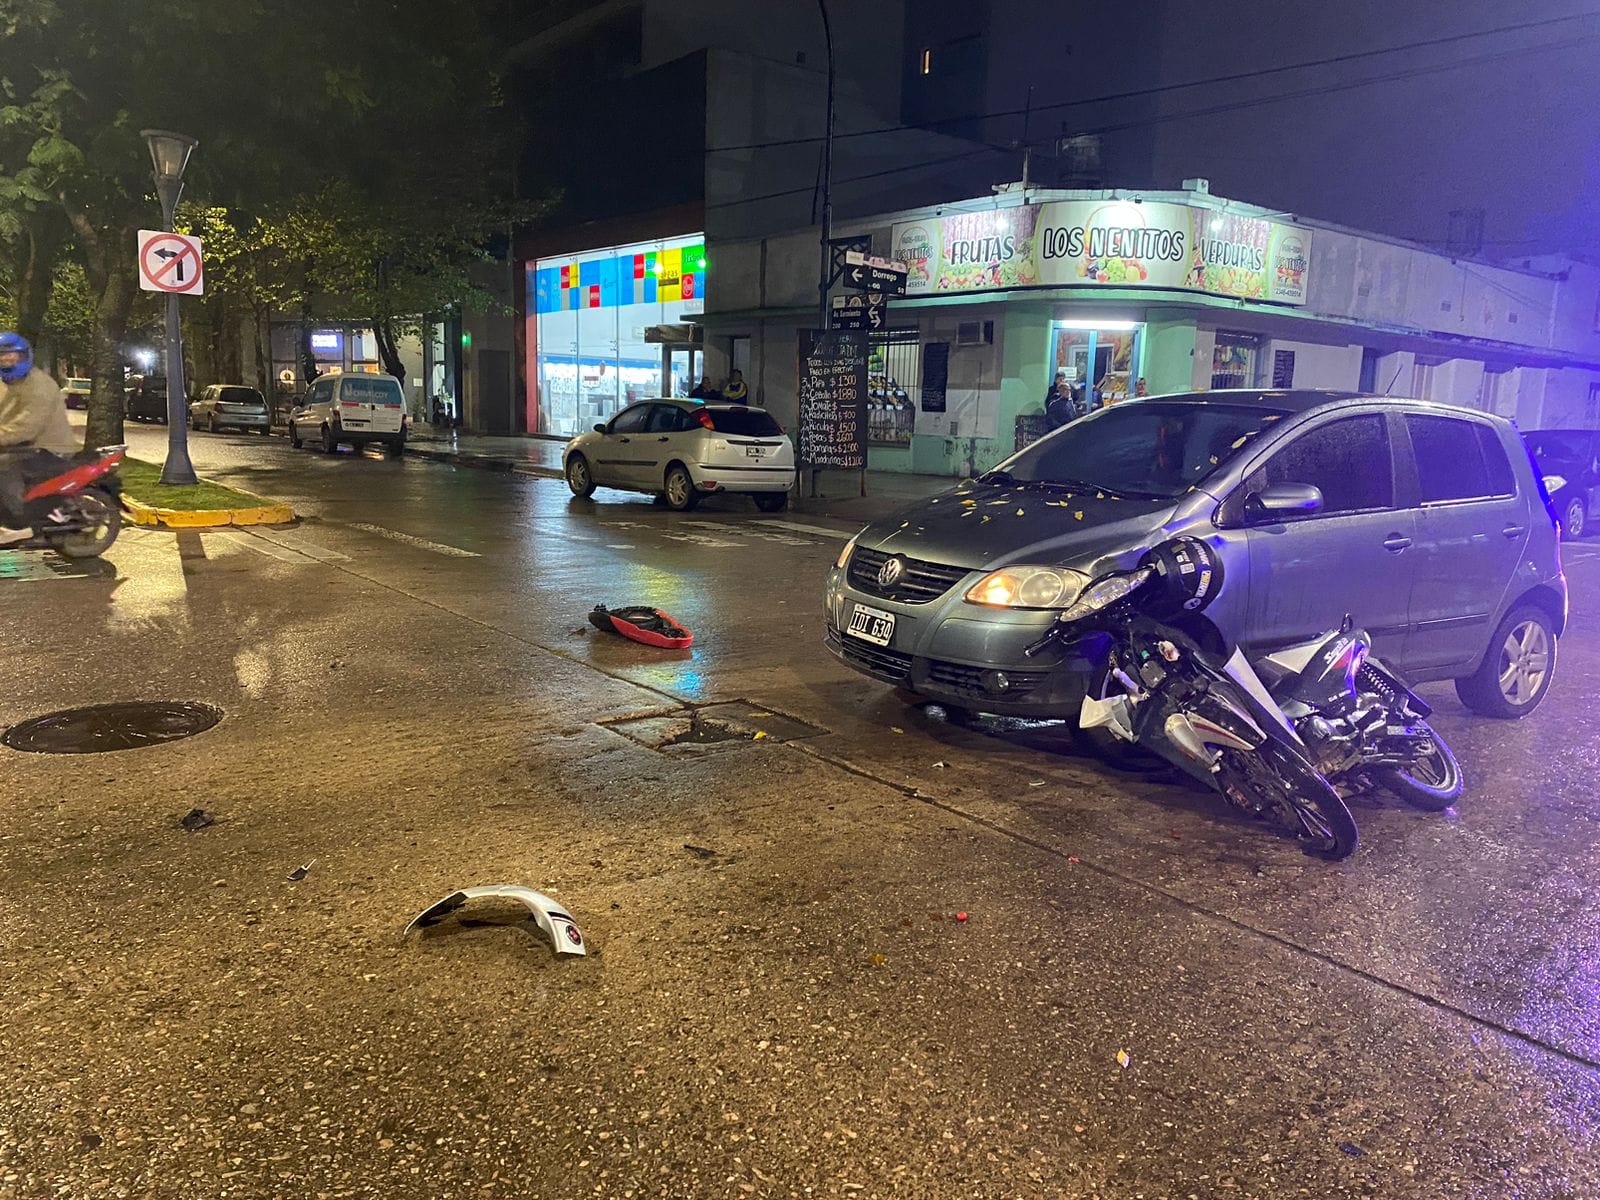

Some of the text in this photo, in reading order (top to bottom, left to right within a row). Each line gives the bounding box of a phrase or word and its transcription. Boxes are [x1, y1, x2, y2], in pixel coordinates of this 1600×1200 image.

[951, 235, 1015, 266] FRUTAS
[1043, 227, 1185, 262] LOS NENITOS
[1200, 237, 1263, 271] VERDURAS
[872, 269, 897, 282] Dorrego
[838, 374, 857, 387] 1300
[851, 612, 871, 632] IDI
